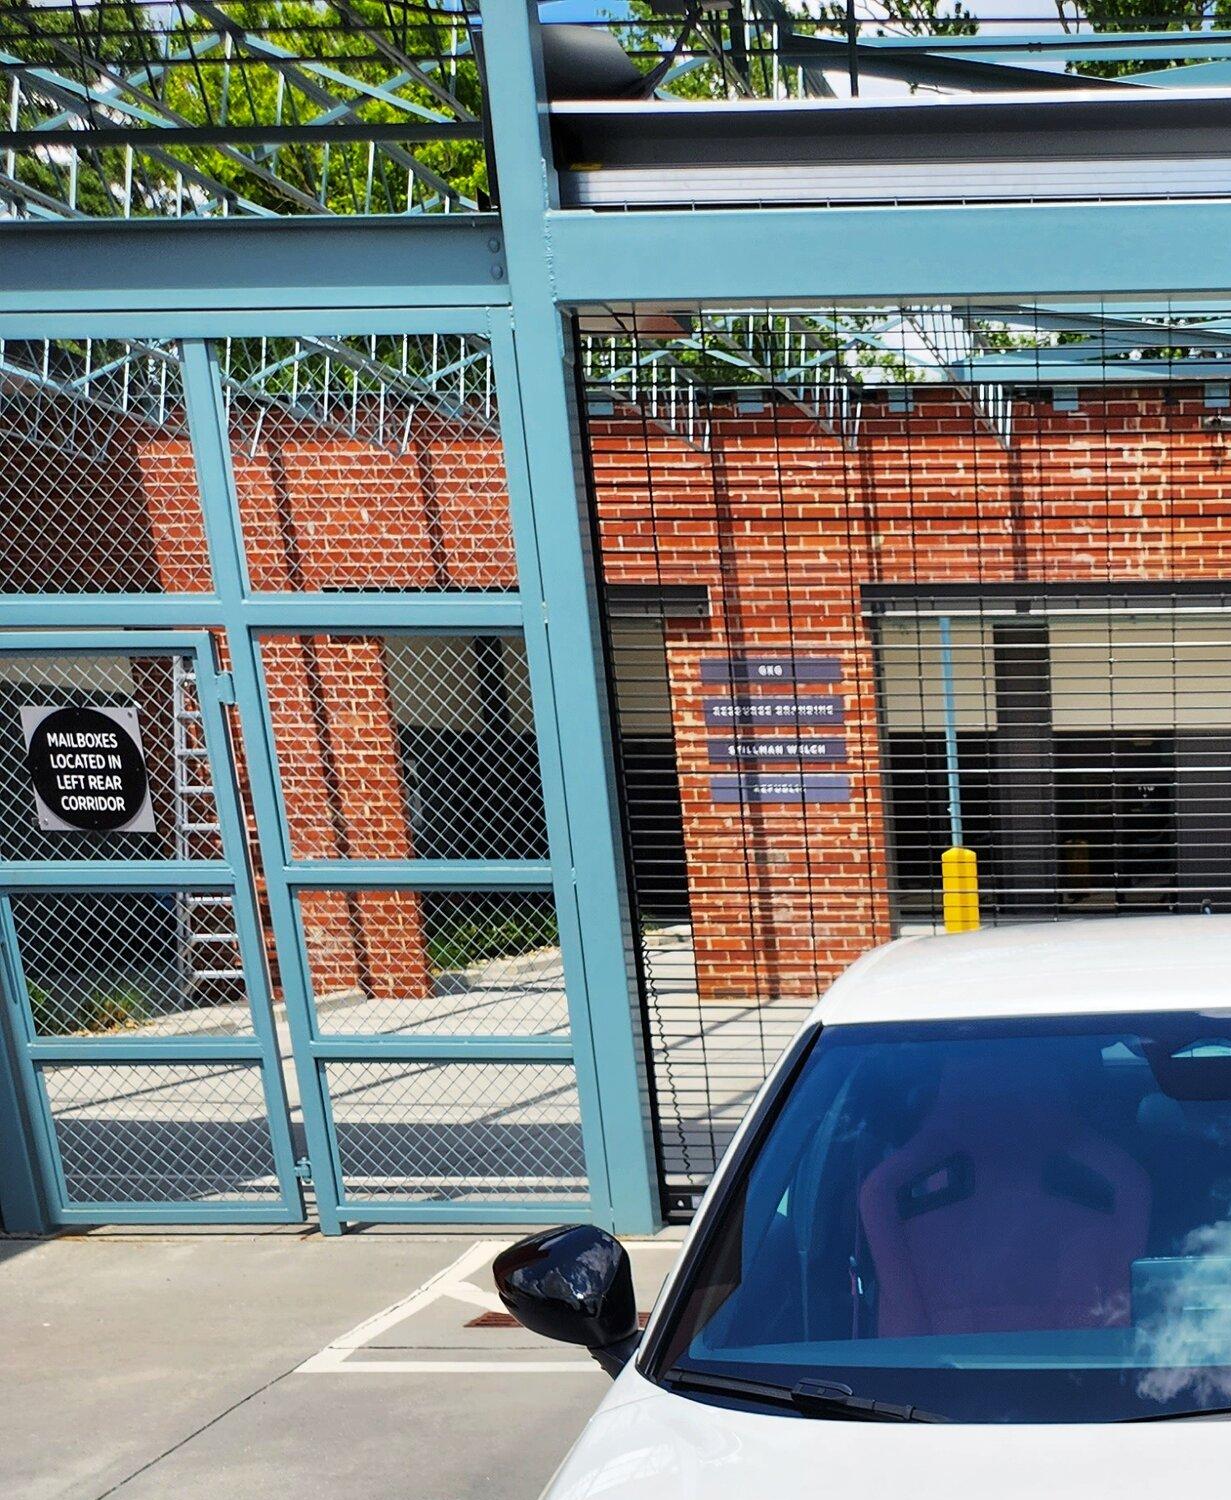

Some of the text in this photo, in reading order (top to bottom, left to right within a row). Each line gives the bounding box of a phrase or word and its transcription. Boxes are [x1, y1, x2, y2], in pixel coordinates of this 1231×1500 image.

[46, 731, 118, 749] MAILBOXES
[49, 753, 122, 770] LOCATED IN
[56, 774, 123, 791] LEFT REAR
[60, 795, 126, 812] CORRIDOR
